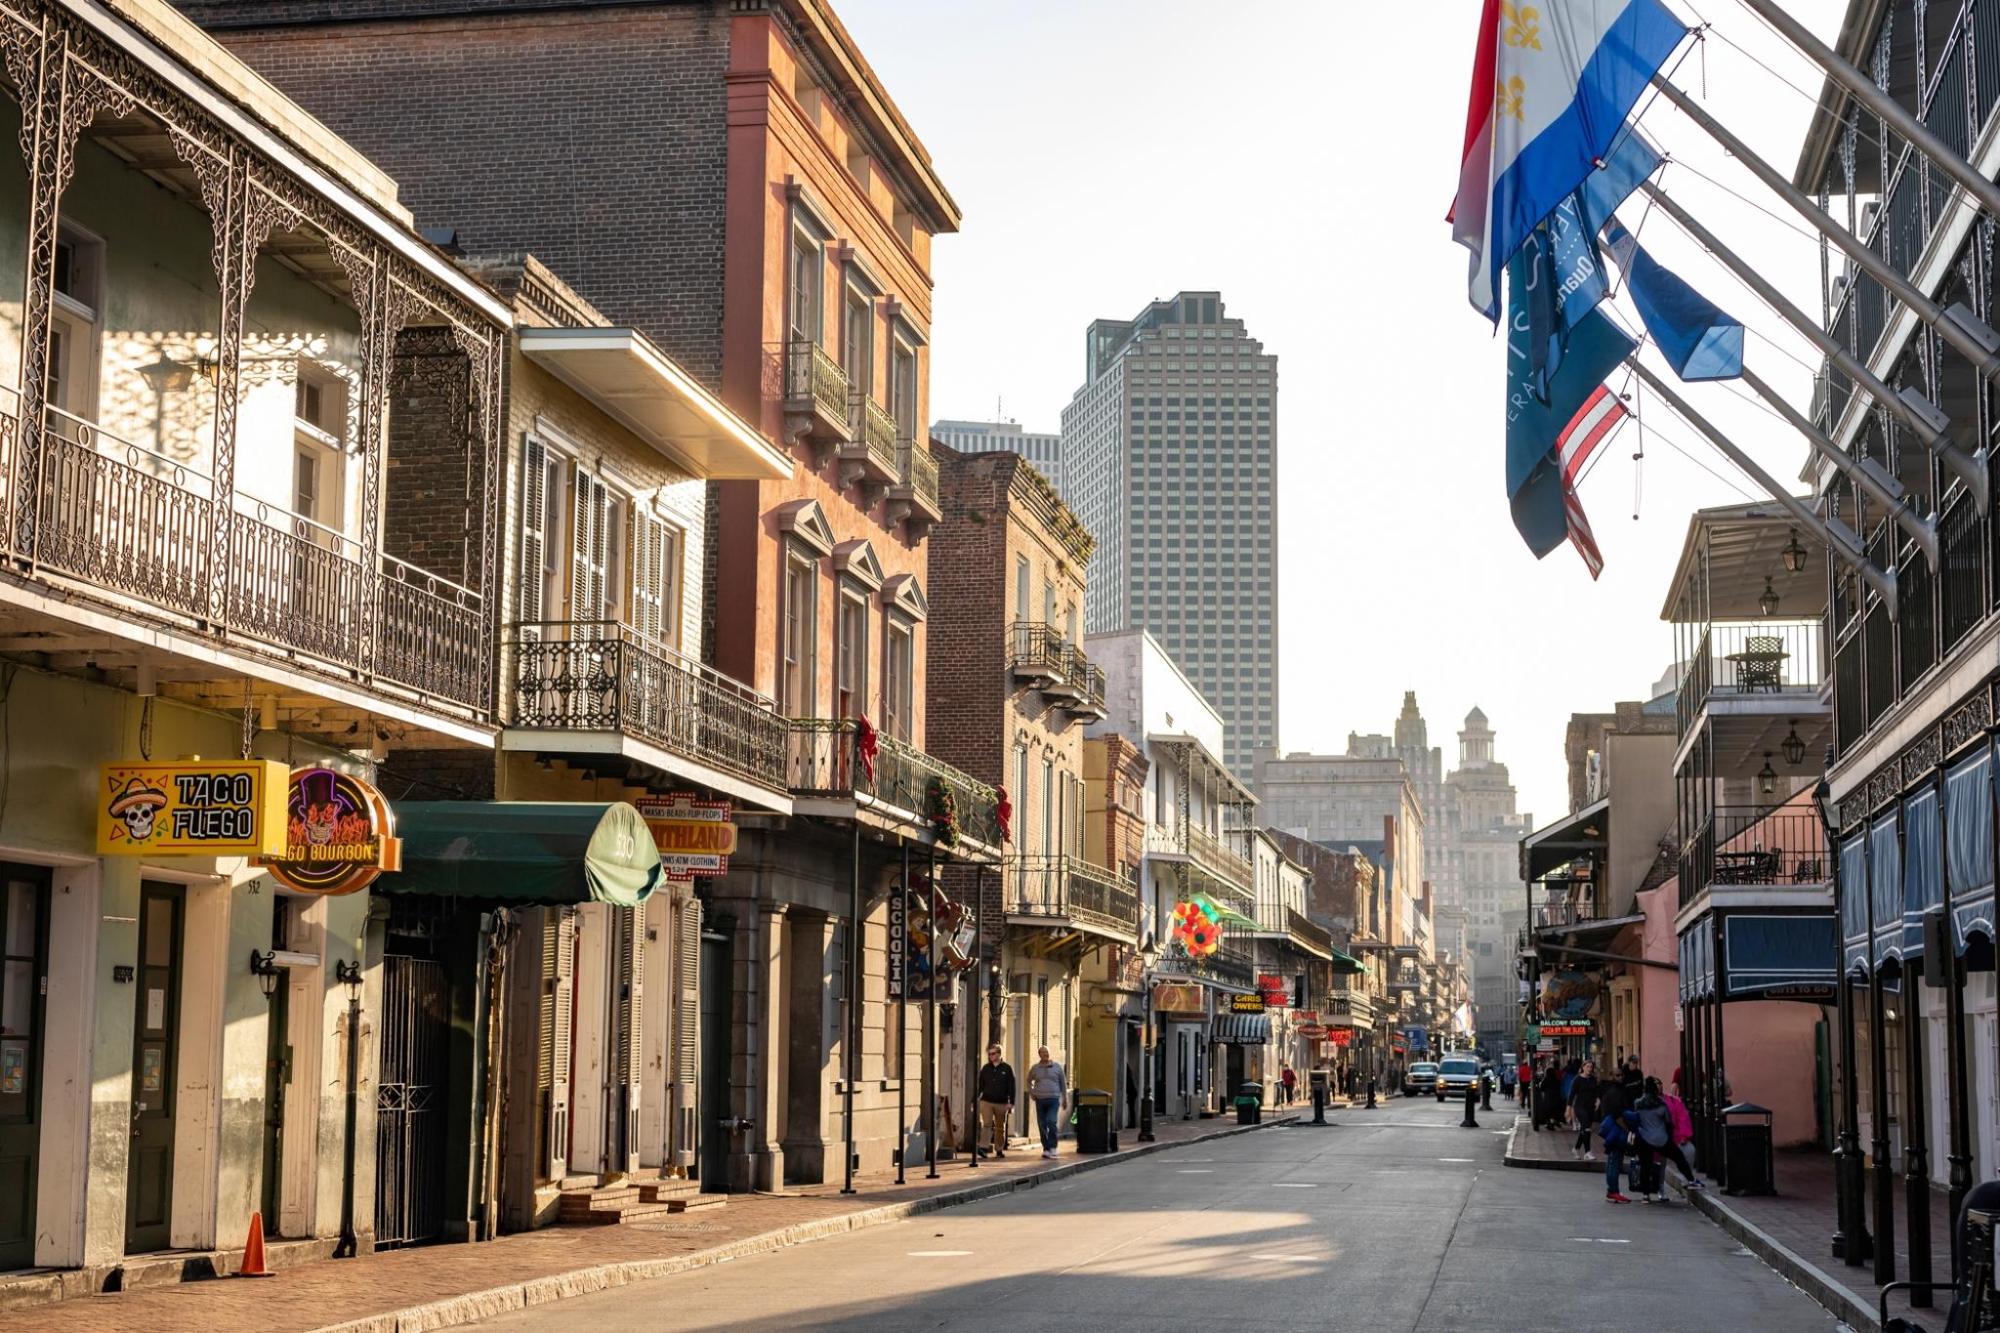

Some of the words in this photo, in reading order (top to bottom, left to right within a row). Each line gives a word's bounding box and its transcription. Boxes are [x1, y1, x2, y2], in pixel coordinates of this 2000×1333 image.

[175, 773, 252, 806] TACO
[172, 807, 253, 839] FUEGO
[310, 844, 373, 860] BOURBON
[690, 856, 718, 867] CLOTHING
[248, 880, 260, 895] 532
[891, 897, 902, 994] SCOOTIN
[1232, 1002, 1263, 1010] OWENS
[1235, 995, 1262, 1003] CHRIS
